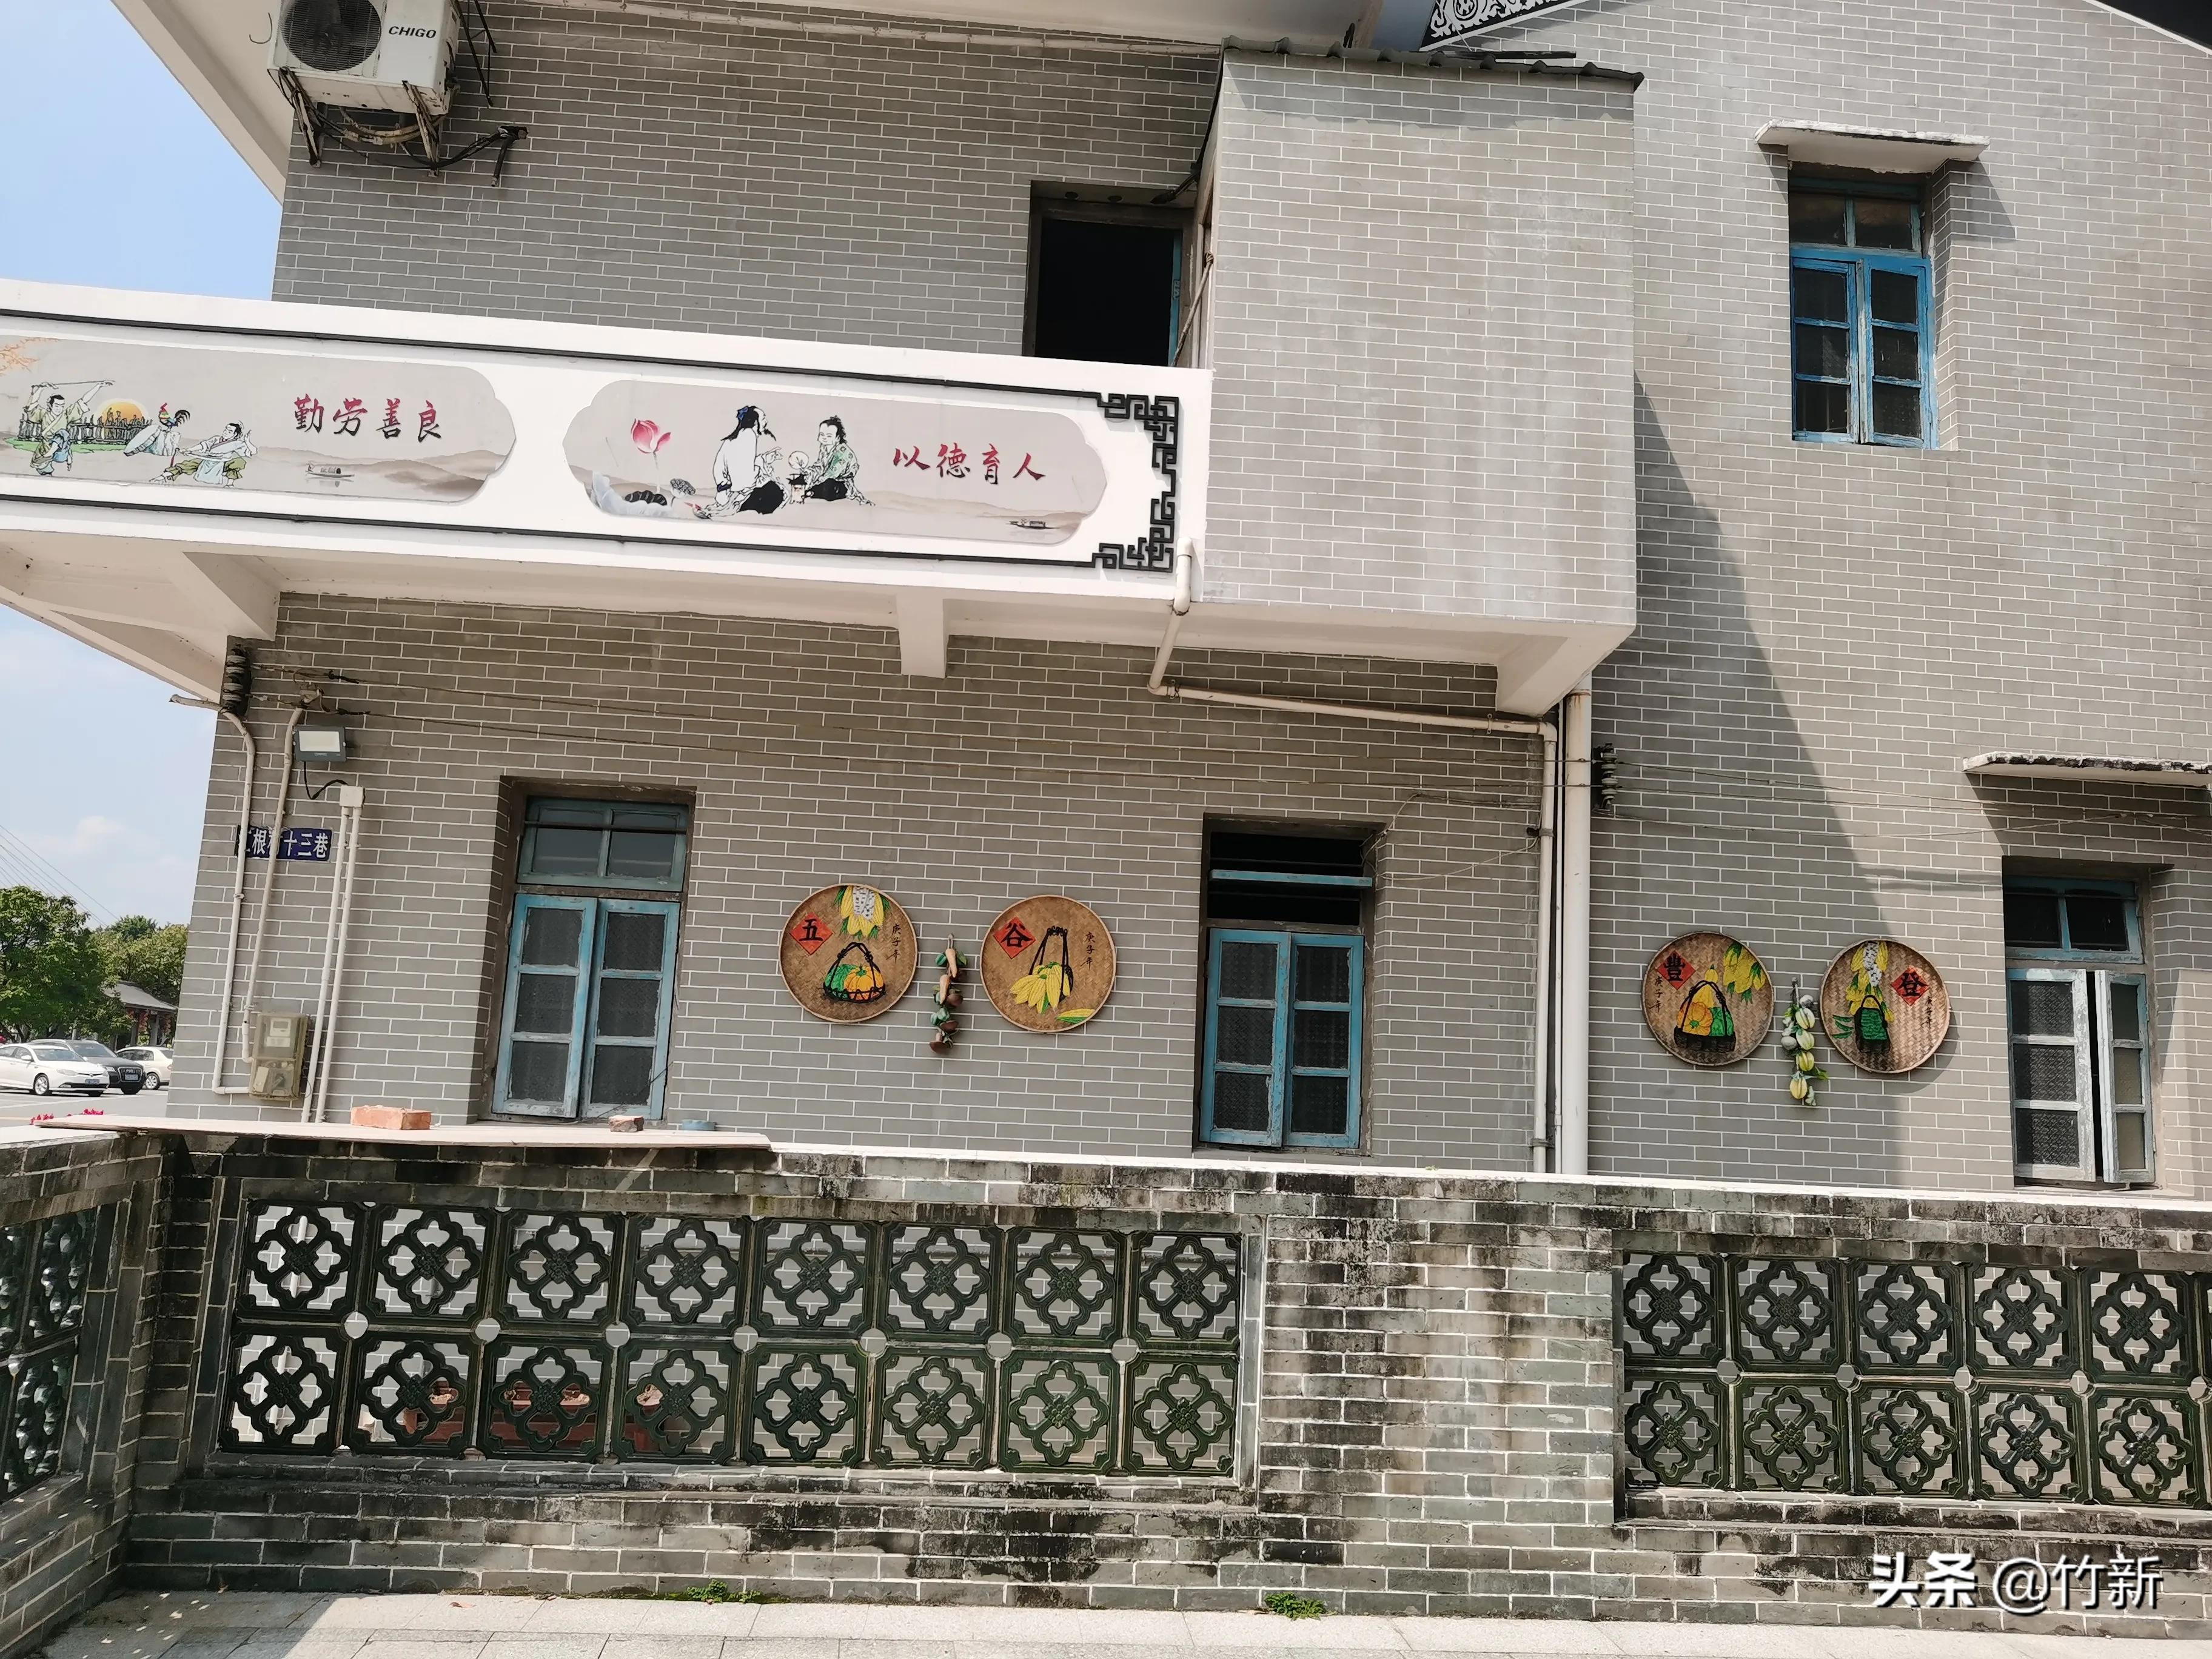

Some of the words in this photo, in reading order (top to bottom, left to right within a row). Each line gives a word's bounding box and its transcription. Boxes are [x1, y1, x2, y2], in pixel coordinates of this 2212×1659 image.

[388, 25, 437, 39] CHIGO
[293, 393, 441, 443] 勤劳善良
[893, 442, 1046, 485] 以德育人
[240, 827, 329, 859] 根十三巷
[799, 918, 824, 942] 五
[1000, 922, 1031, 948] 谷
[1896, 971, 1929, 997] 登
